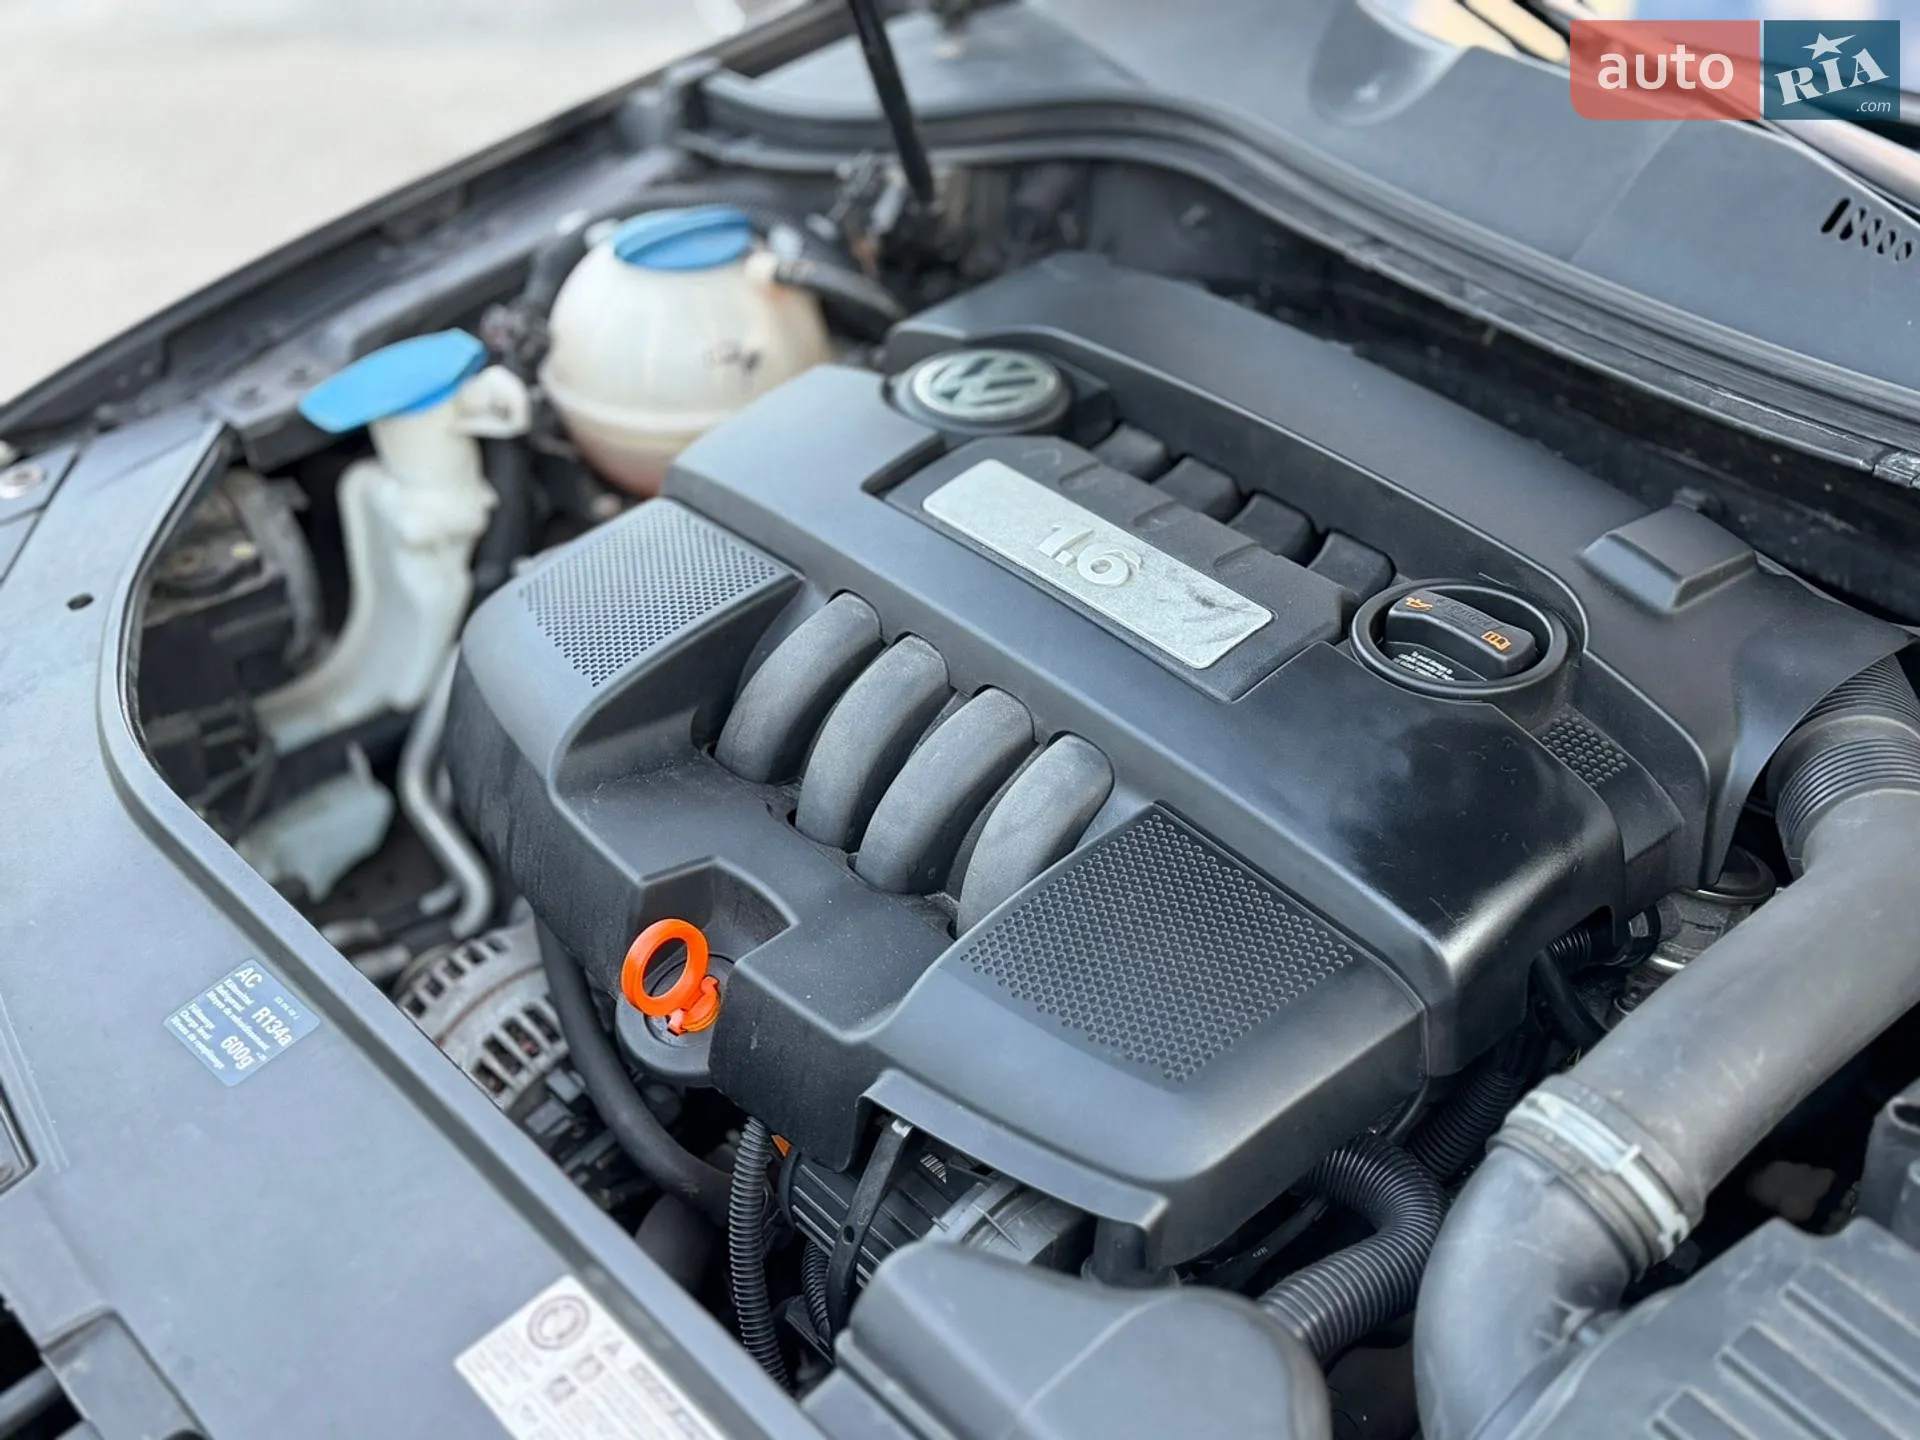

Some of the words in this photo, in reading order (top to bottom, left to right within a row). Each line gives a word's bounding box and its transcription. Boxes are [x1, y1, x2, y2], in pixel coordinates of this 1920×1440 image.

[1037, 525, 1143, 588] 1.6
[235, 967, 263, 988] AC
[251, 1006, 293, 1046] R134a
[221, 1035, 255, 1070] 600g
